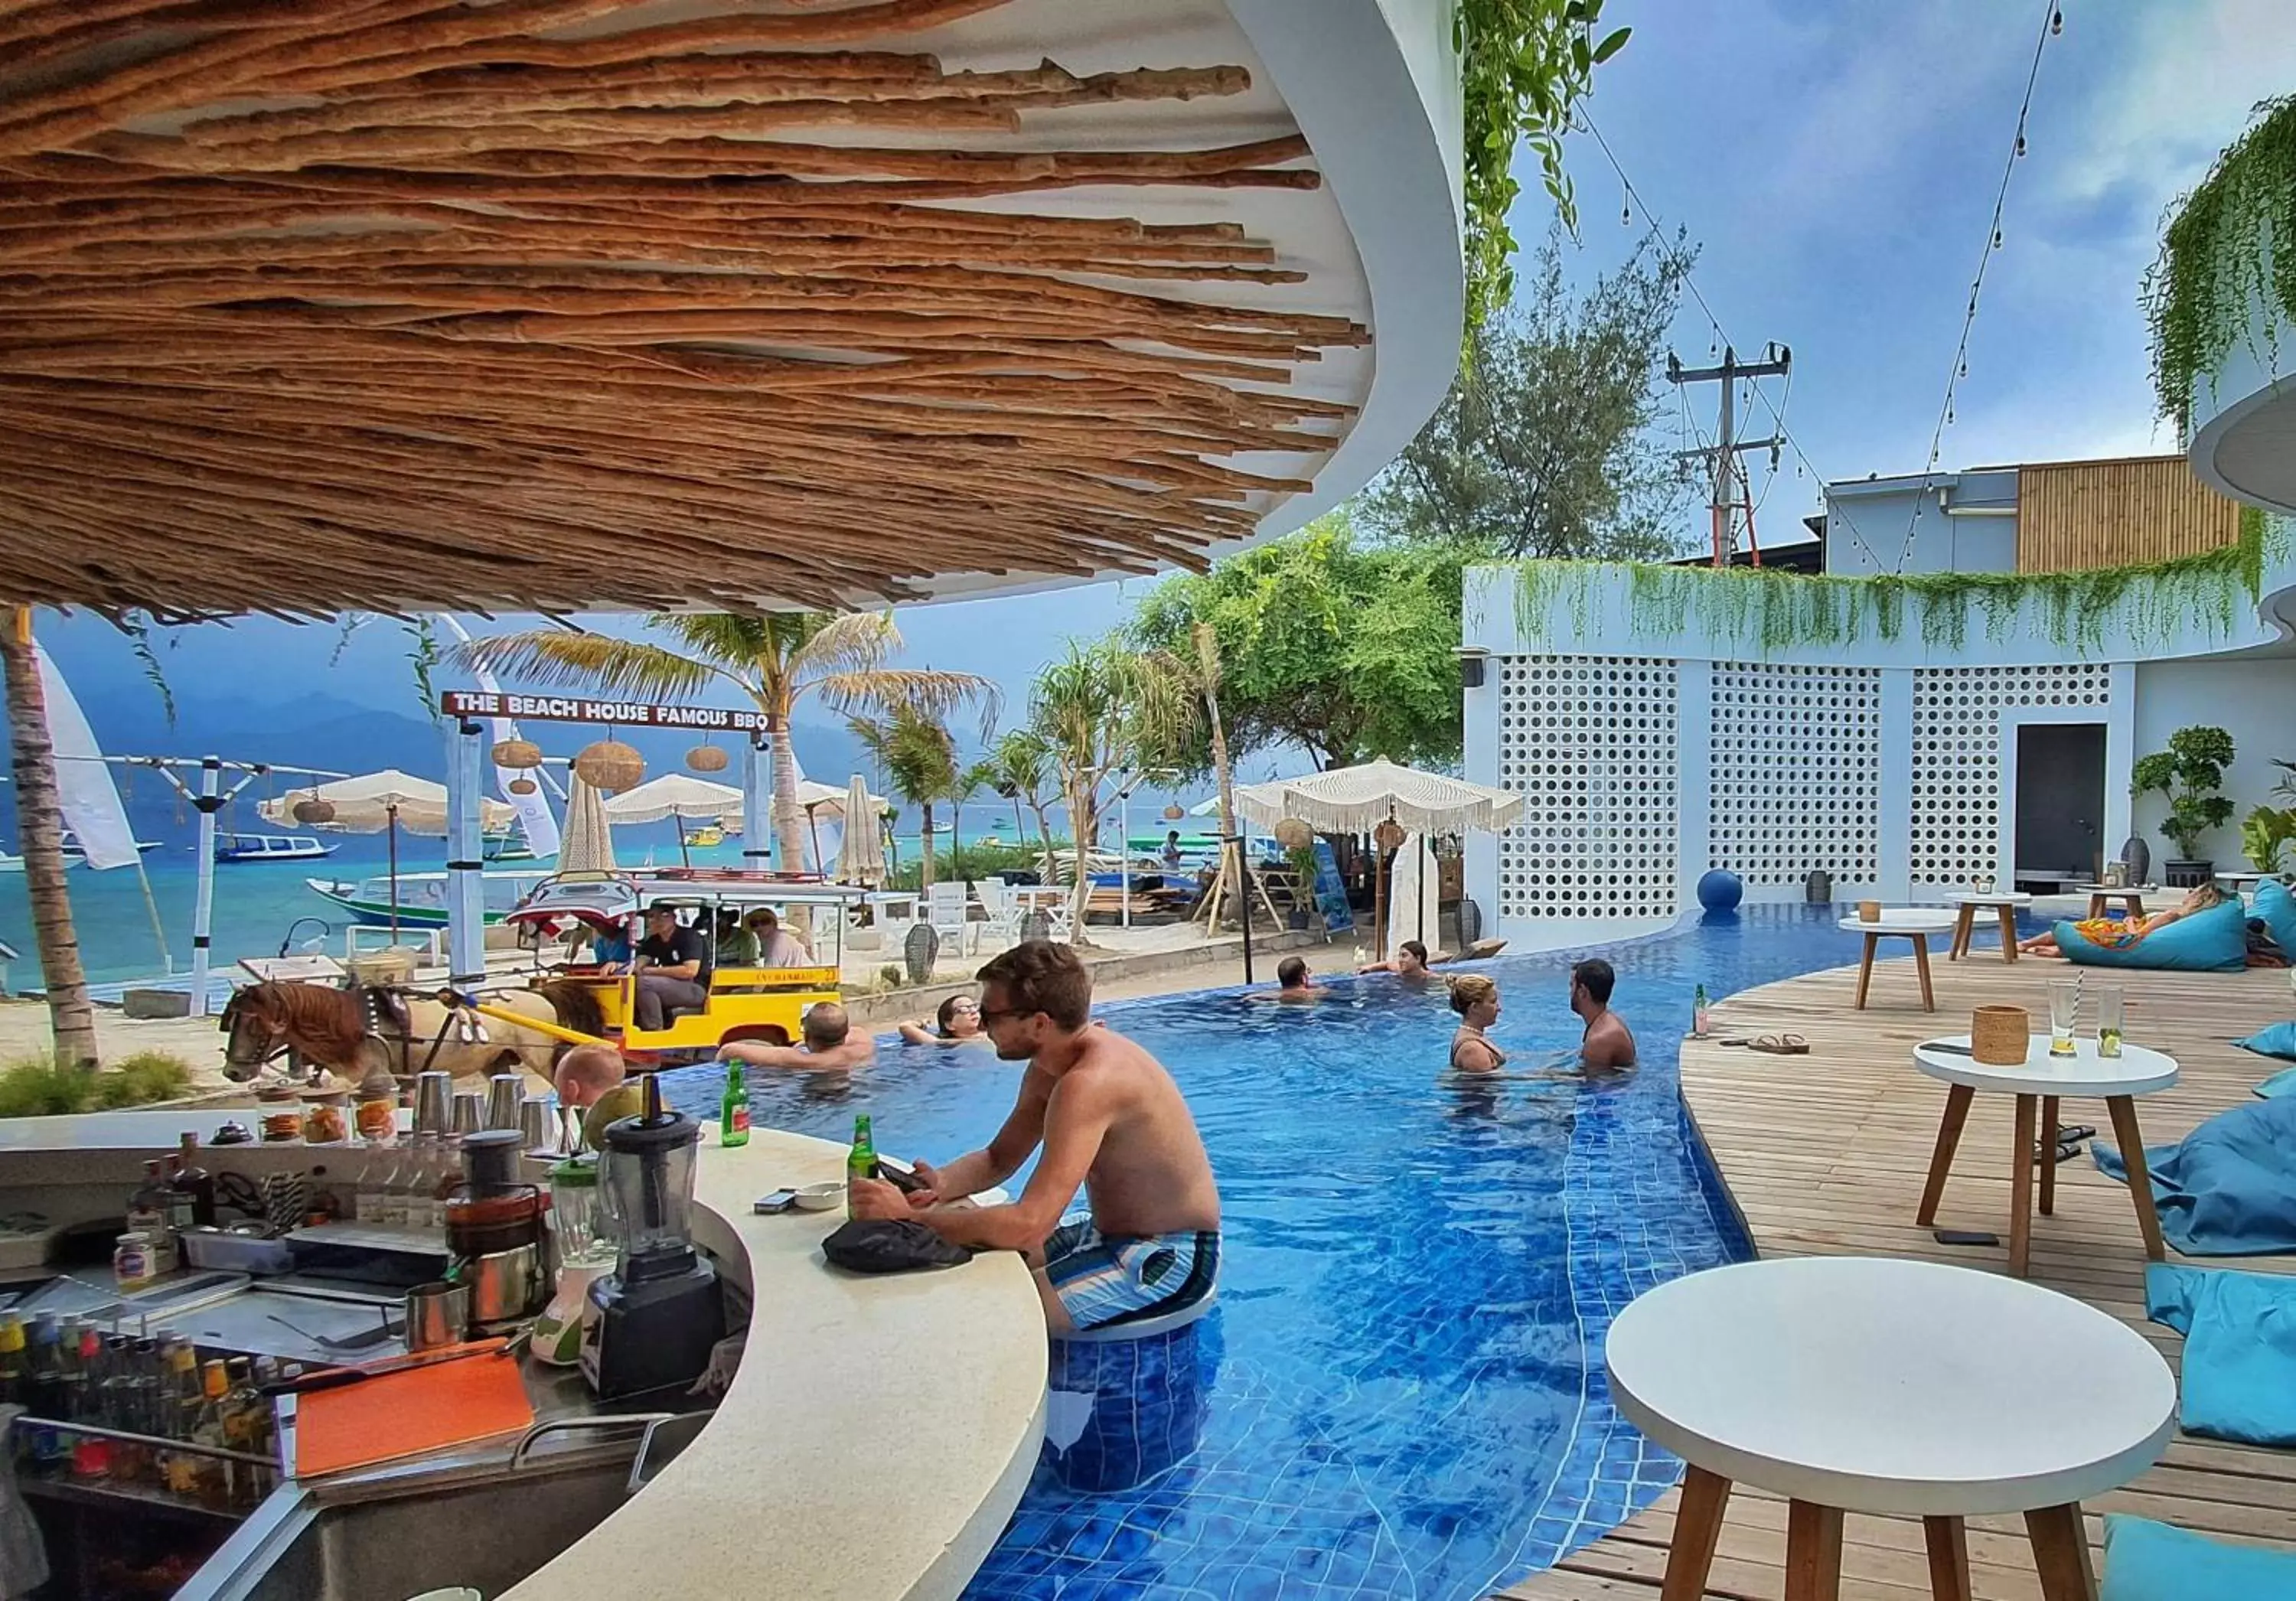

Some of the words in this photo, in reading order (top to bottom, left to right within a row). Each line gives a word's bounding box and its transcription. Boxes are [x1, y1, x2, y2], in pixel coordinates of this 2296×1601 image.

[455, 693, 499, 712] THE
[508, 696, 578, 717] BEACH
[585, 703, 649, 722] HOUSE
[657, 707, 728, 726] FAMOUS
[734, 713, 768, 730] BBQ
